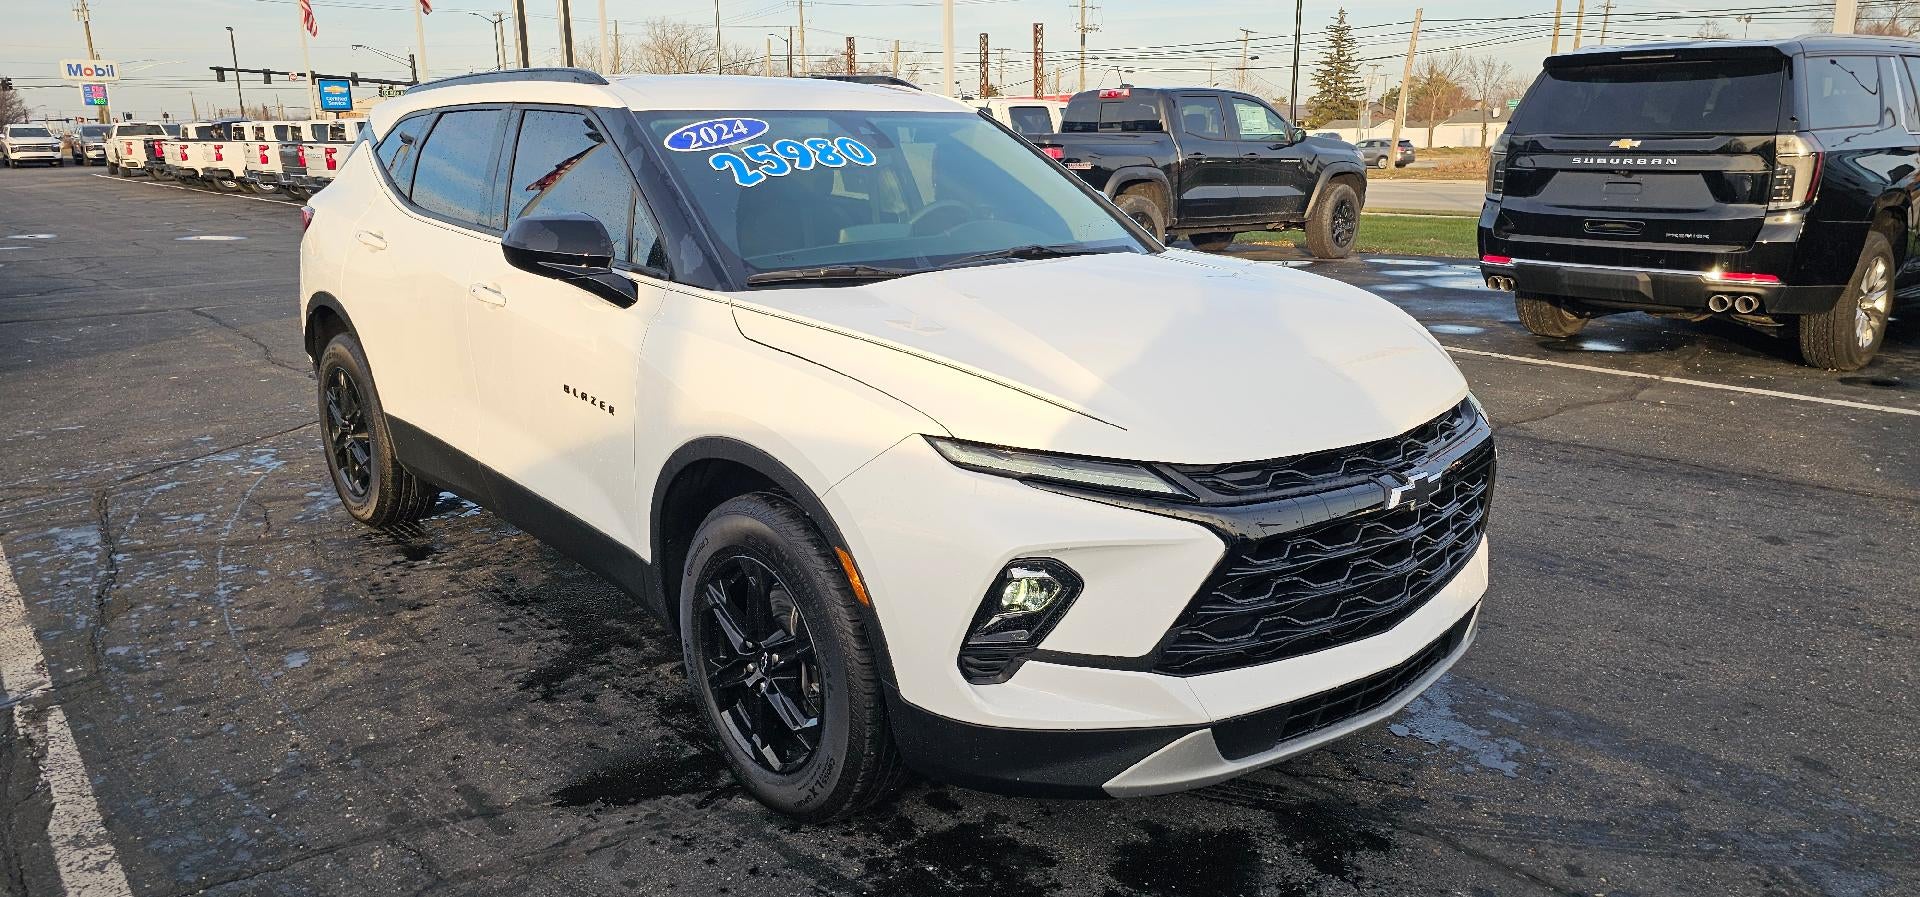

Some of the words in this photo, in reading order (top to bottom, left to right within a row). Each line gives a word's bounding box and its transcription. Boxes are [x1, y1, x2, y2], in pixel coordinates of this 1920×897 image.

[66, 63, 115, 77] Mobil
[682, 119, 749, 149] 2024
[709, 136, 877, 188] 25980
[1571, 157, 1677, 165] SUBURBAN
[563, 384, 615, 416] BLAZER
